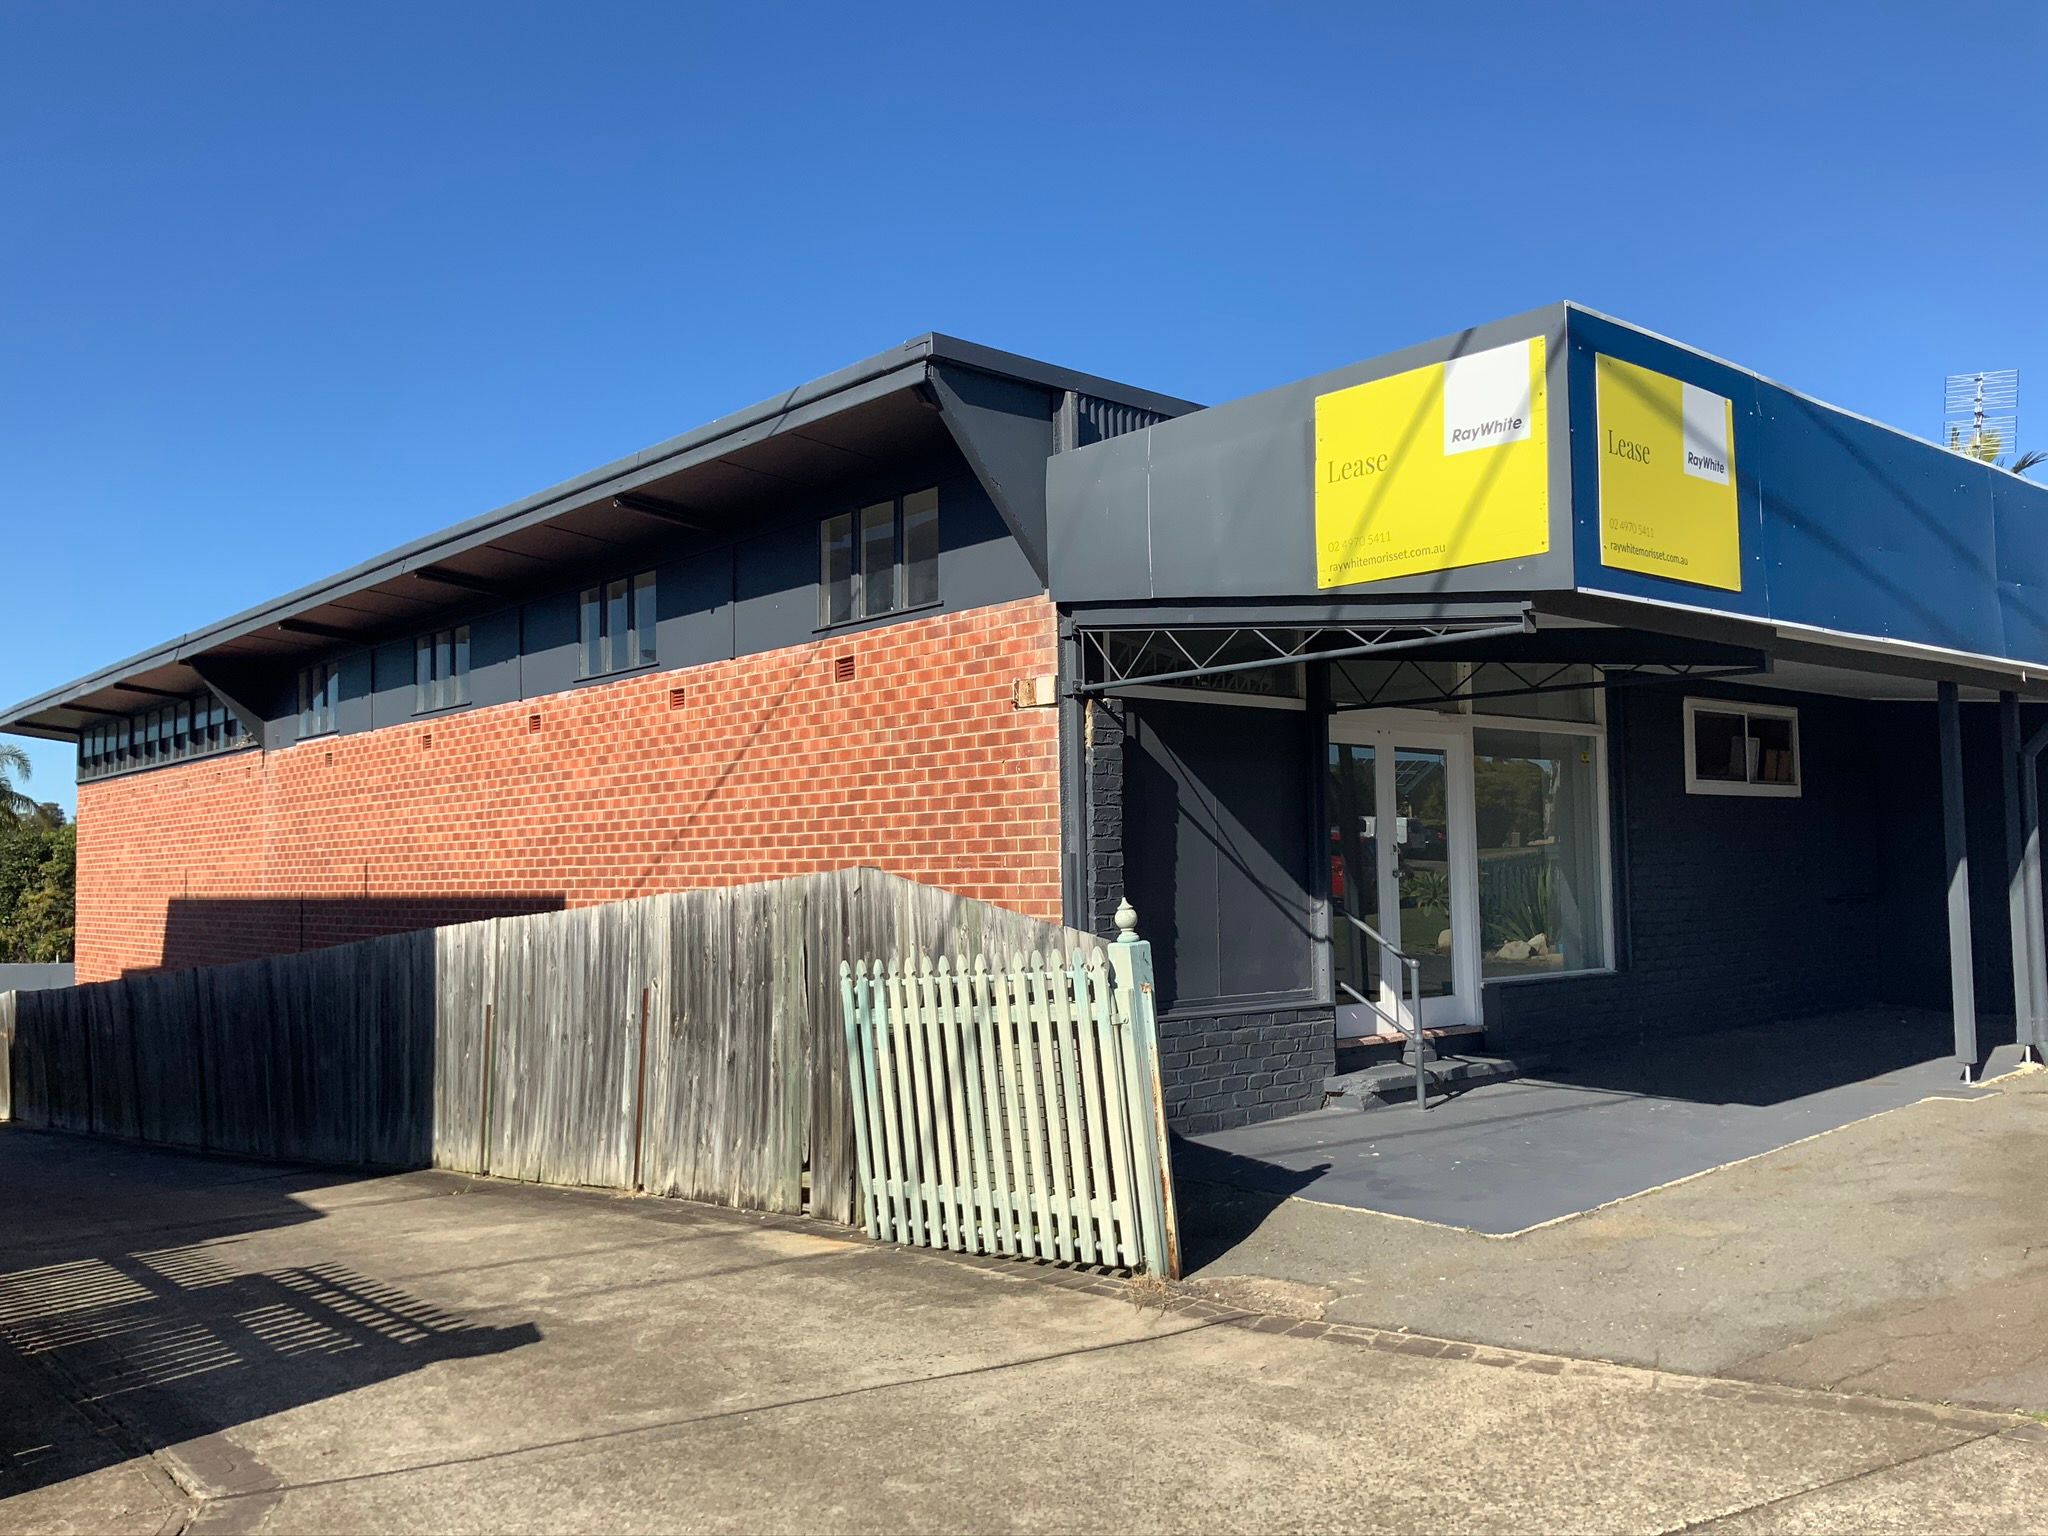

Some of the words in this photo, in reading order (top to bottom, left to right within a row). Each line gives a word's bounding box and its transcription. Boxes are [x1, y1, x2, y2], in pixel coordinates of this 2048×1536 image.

[1608, 429, 1650, 464] Lease
[1328, 453, 1388, 484] Lease
[1609, 518, 1619, 530] 02
[1328, 541, 1340, 553] 02
[1342, 535, 1366, 549] 4970
[1367, 530, 1392, 545] 5411
[1610, 542, 1689, 566] raywhitemorisset.com.au
[1329, 544, 1446, 573] raywhitemorisset.com.au
